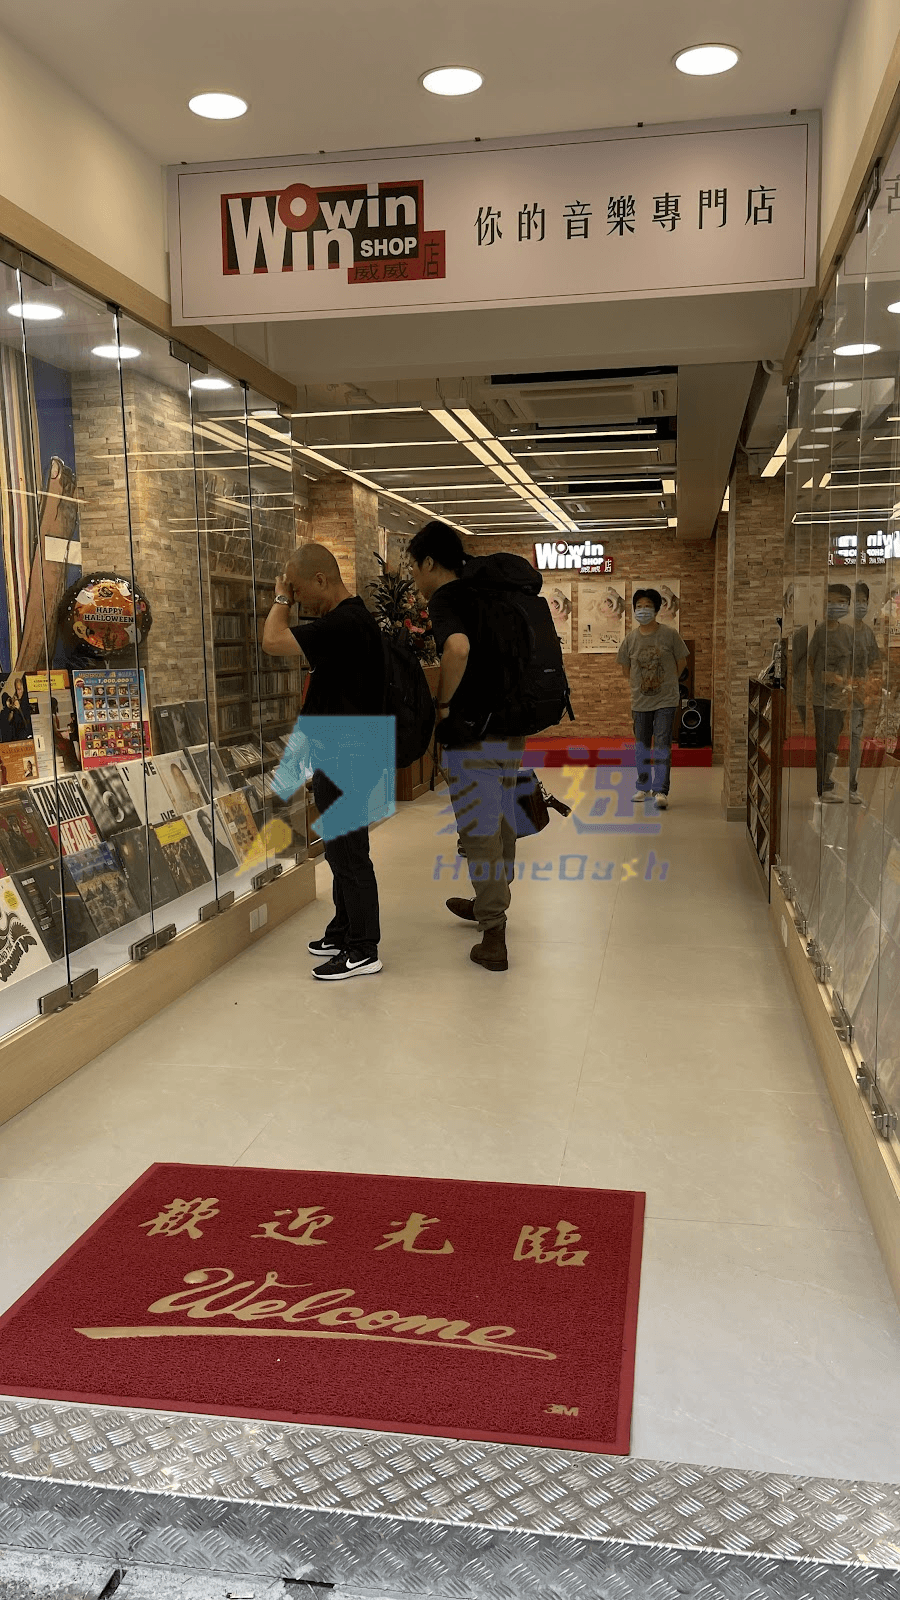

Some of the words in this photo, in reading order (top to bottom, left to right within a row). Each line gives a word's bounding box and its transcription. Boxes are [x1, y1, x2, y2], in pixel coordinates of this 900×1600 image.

[473, 185, 777, 247] 你的音樂專門店
[360, 236, 418, 257] SHOP
[582, 557, 604, 566] SHOP
[84, 614, 135, 623] HALLOWEEN
[96, 606, 123, 614] HAPPY
[137, 1197, 590, 1267] 歡迎光臨
[146, 1267, 518, 1345] Welcome
[543, 1403, 580, 1417] 3M
